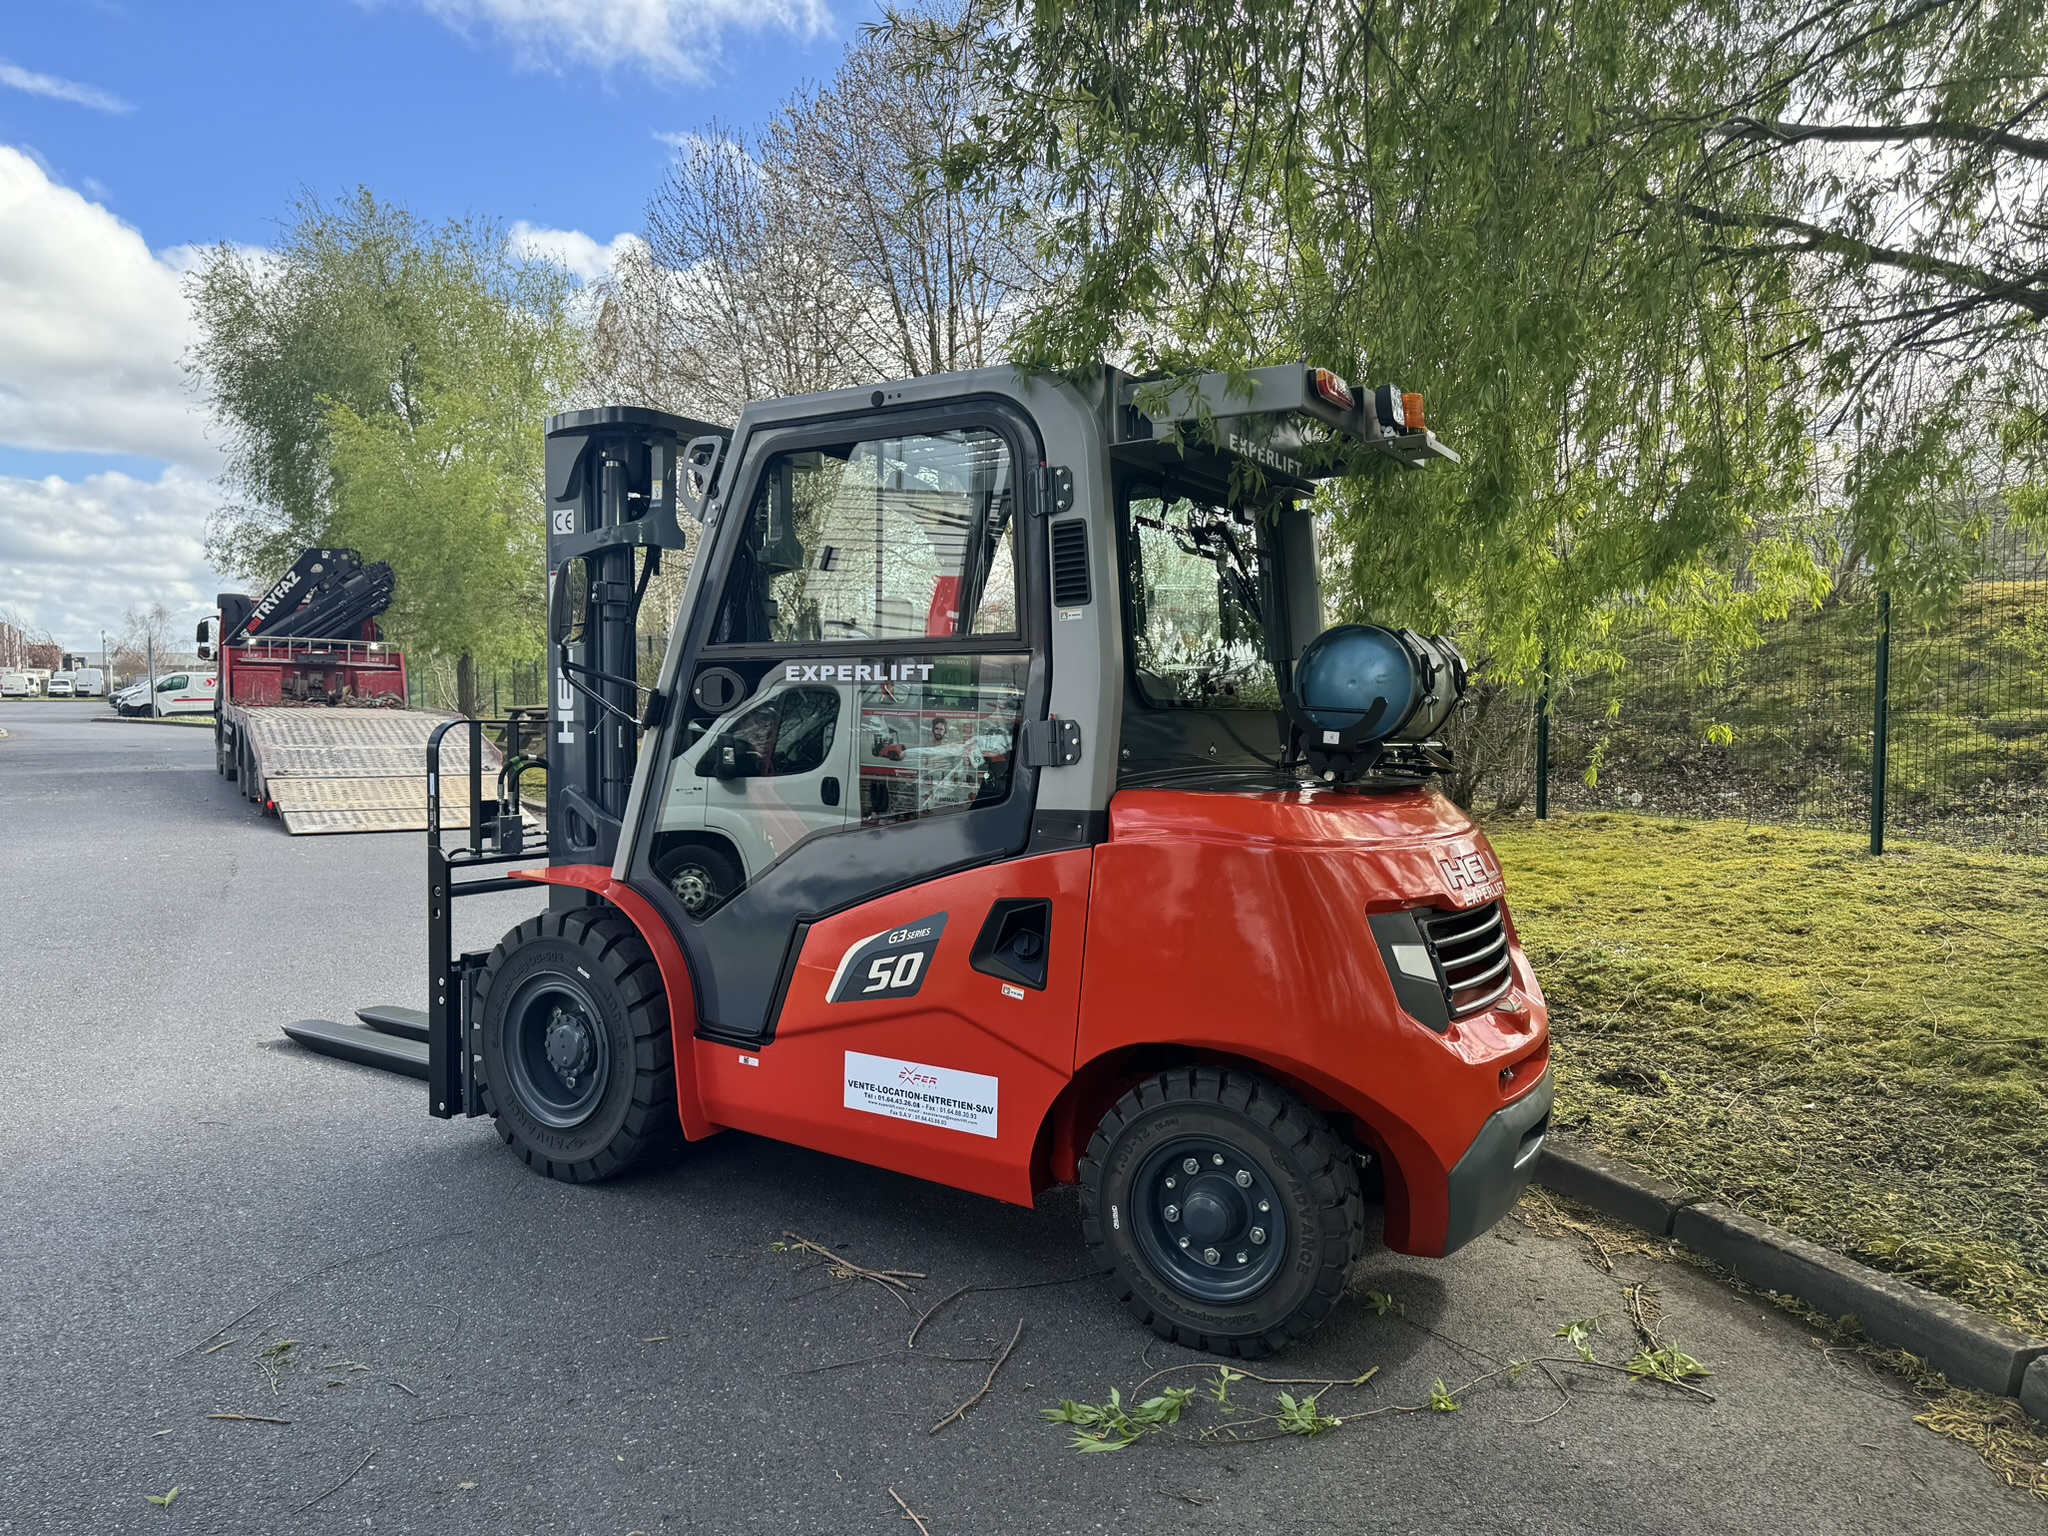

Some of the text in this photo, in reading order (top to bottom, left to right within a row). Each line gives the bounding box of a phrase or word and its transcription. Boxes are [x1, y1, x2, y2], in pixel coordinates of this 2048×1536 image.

[1229, 433, 1303, 477] EXPERLIFT
[554, 512, 573, 531] CE
[252, 570, 301, 621] TRYFAZ
[785, 664, 934, 681] EXPERLIFT
[557, 645, 575, 744] HEL
[1440, 850, 1500, 890] HELI
[1463, 881, 1506, 906] EXPERLIFT
[888, 927, 931, 944] G3 SERIES
[862, 952, 924, 993] 50
[898, 1065, 938, 1086] EXPER
[848, 1079, 994, 1115] VENTE-LOCATION-ENTRETIEN-SAV
[926, 1104, 936, 1112] Fax
[1288, 1179, 1315, 1276] ADVANCE
